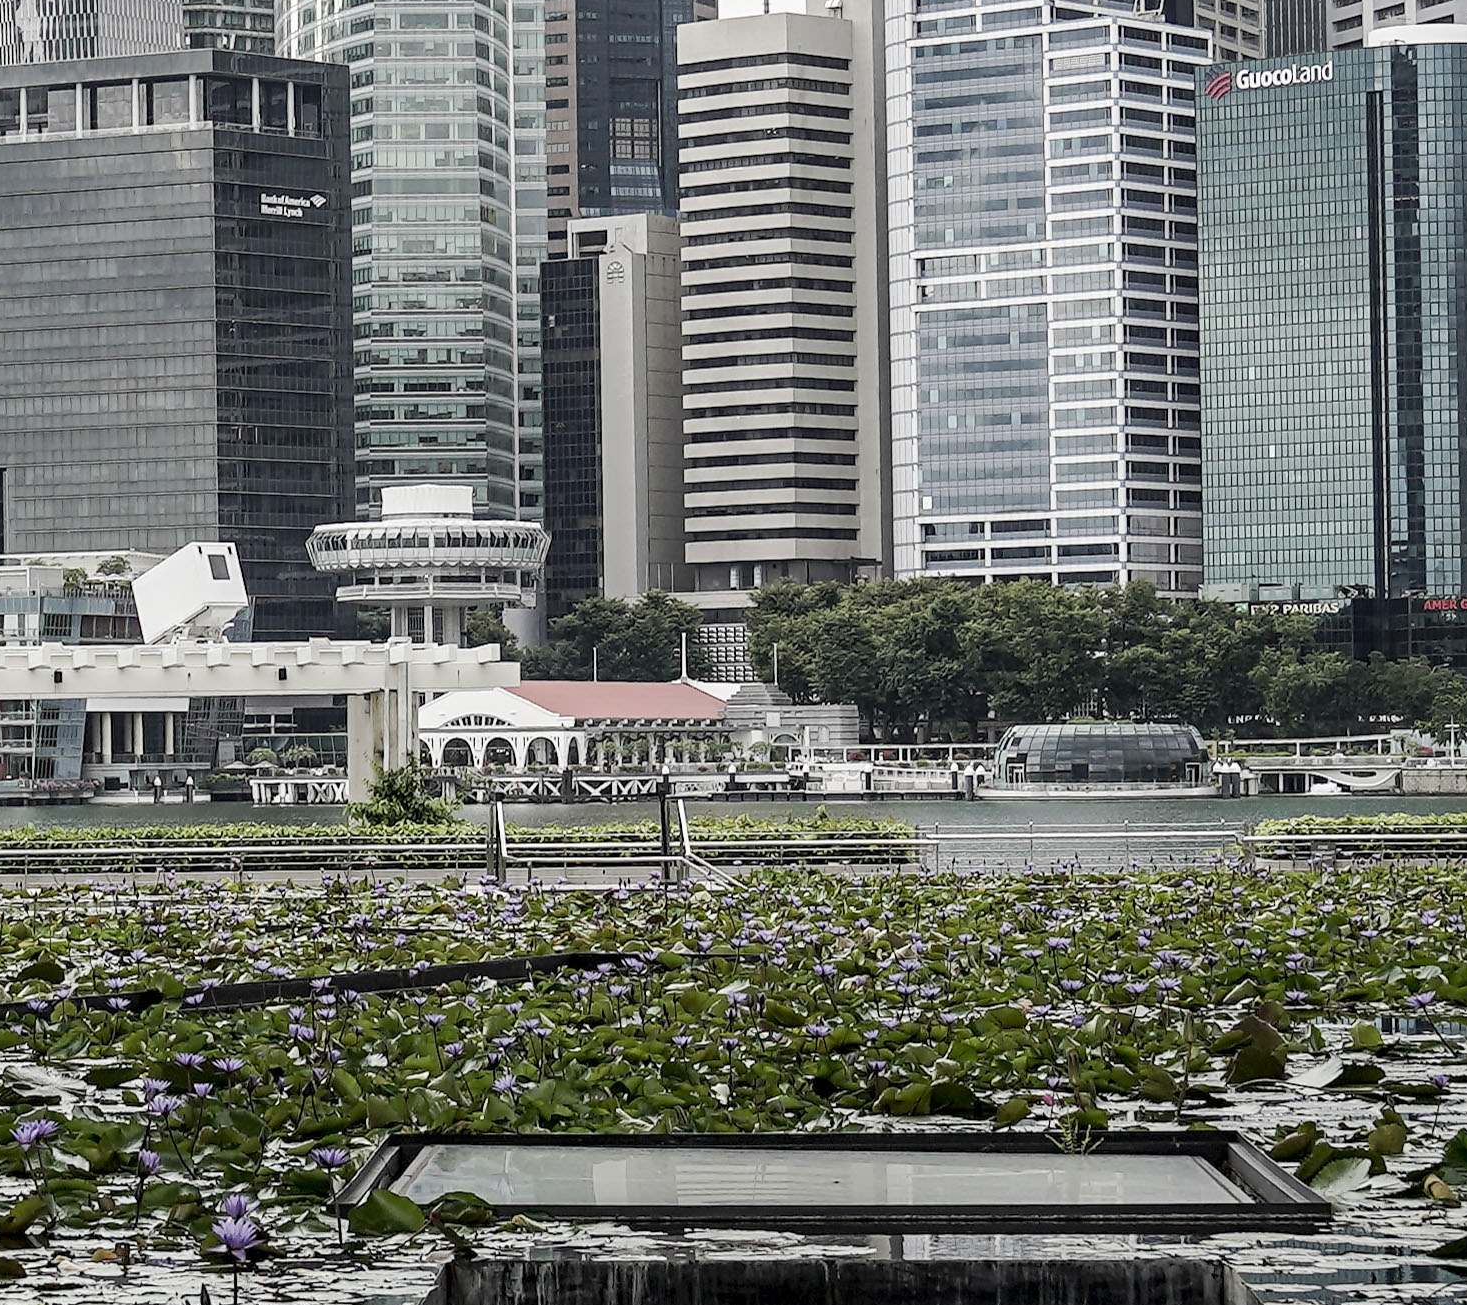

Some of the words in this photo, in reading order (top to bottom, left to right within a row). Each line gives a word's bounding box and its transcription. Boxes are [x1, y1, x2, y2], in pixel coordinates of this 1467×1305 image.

[1236, 61, 1333, 90] GuocoLand
[1282, 602, 1340, 615] PARIBAS
[1424, 599, 1457, 610] AMER
